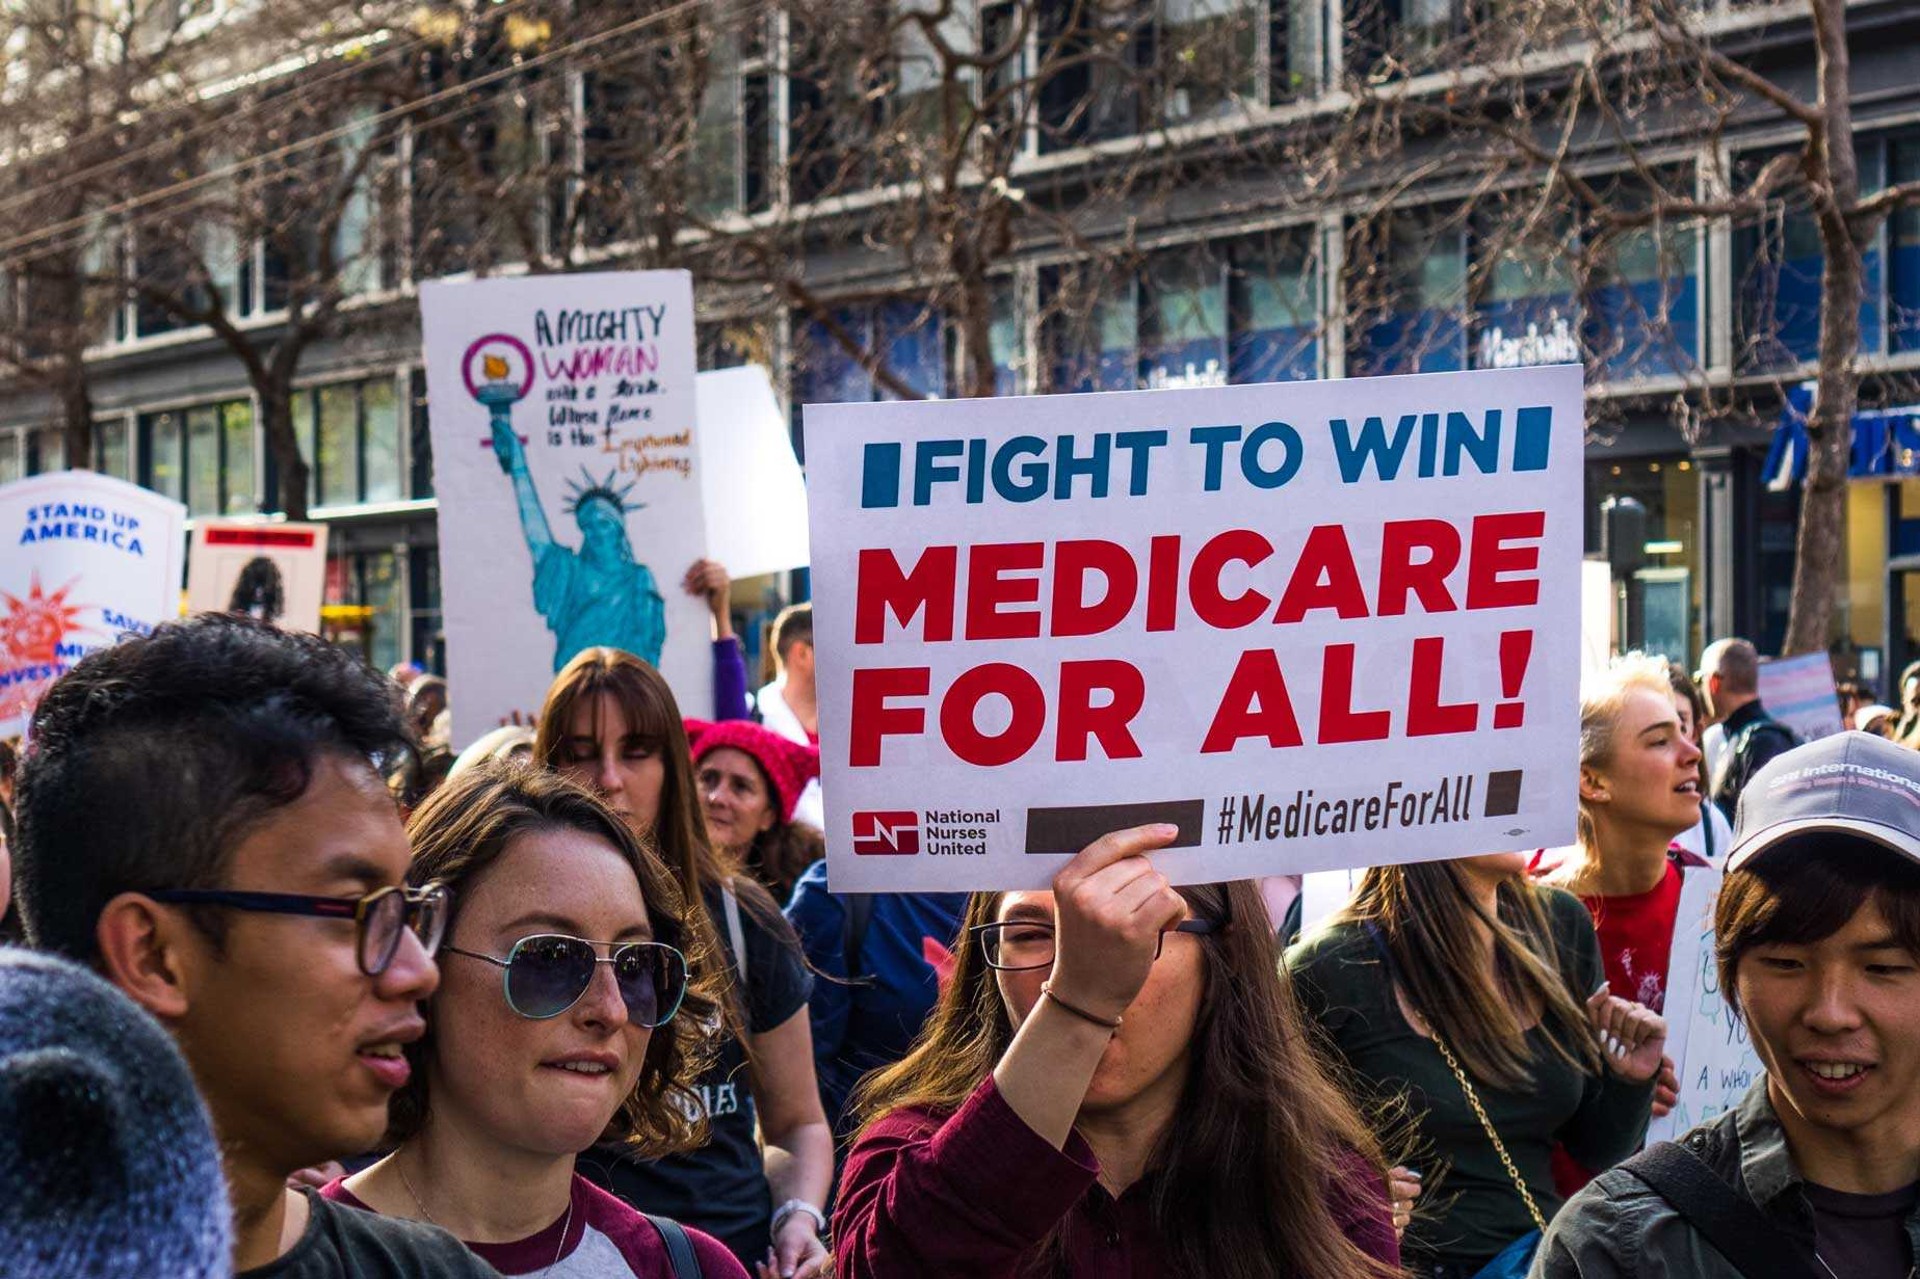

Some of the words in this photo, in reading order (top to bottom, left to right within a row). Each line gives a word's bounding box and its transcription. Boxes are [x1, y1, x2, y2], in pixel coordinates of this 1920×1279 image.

[534, 308, 554, 347] A
[557, 304, 667, 344] MIGHTY
[540, 344, 660, 381] WOMAN
[914, 430, 1168, 506] FIGHT
[1190, 422, 1303, 491] TO
[1330, 410, 1502, 483] WIN
[27, 503, 106, 522] STAND
[111, 511, 140, 530] UP
[19, 522, 143, 557] AMERICA
[855, 512, 1545, 644] MEDICARE
[850, 660, 1145, 767] FOR
[1202, 630, 1533, 753] ALL!
[1801, 763, 1920, 793] Internationa
[925, 809, 1000, 824] National
[1218, 776, 1472, 847] #MedicareForAll
[926, 826, 987, 840] Nurses
[927, 842, 986, 856] United
